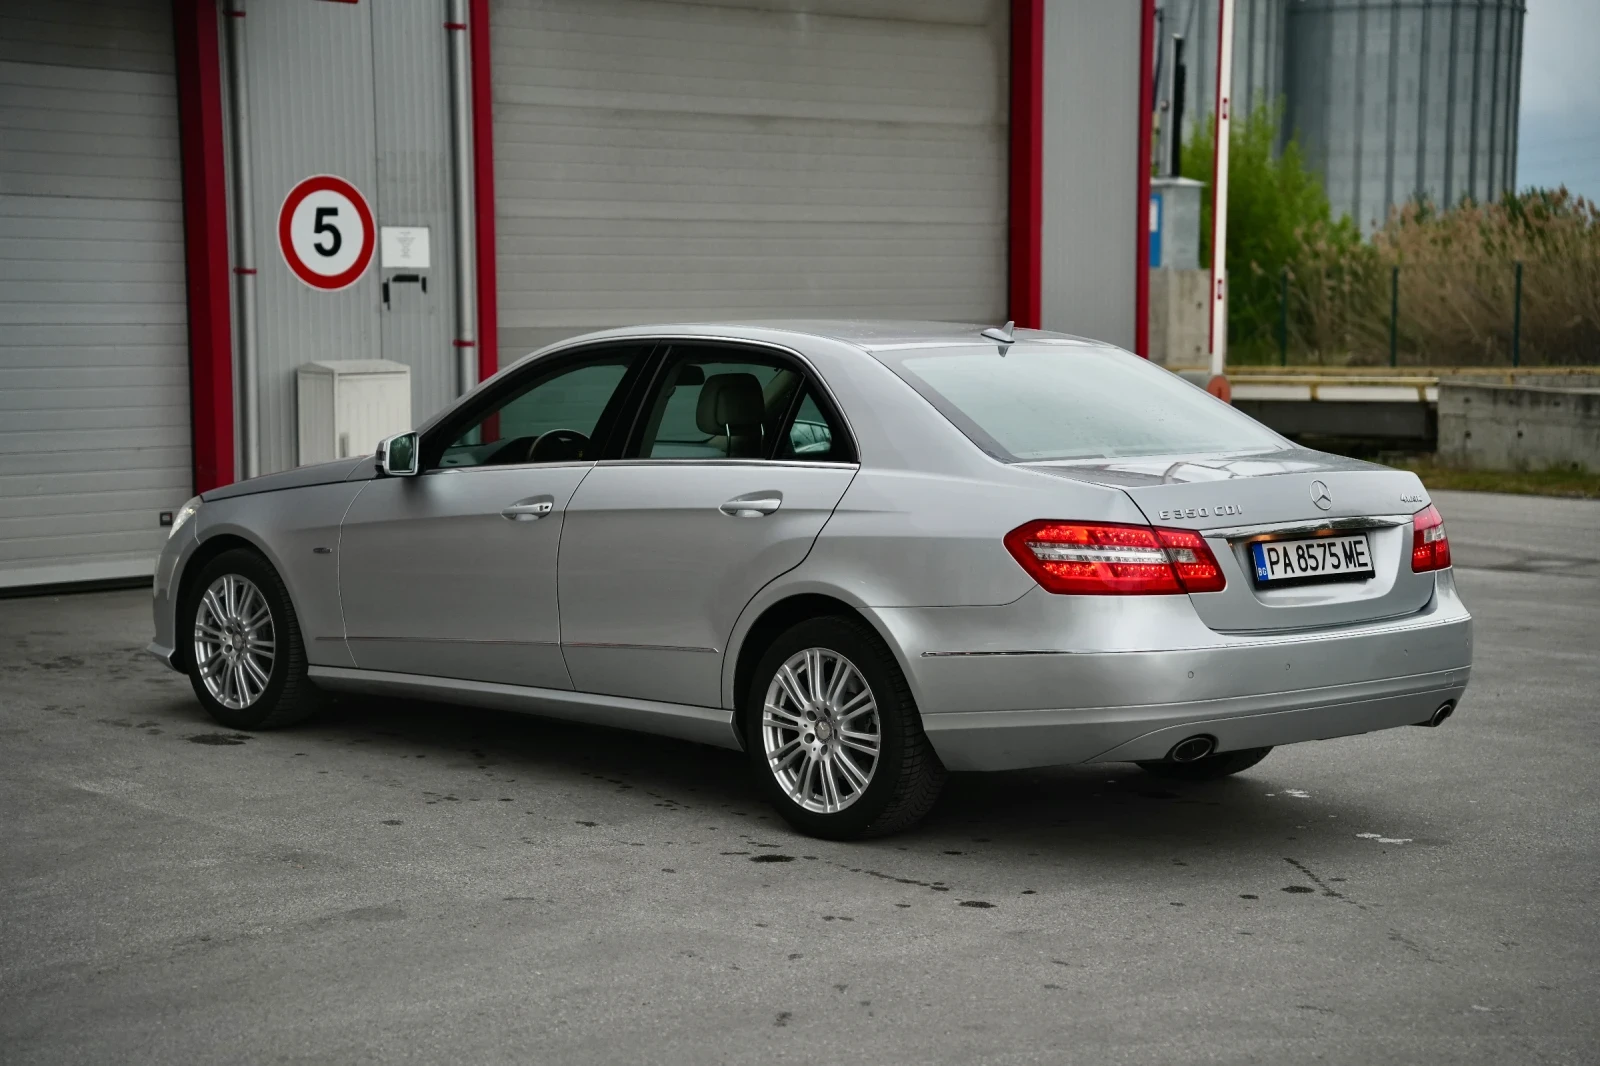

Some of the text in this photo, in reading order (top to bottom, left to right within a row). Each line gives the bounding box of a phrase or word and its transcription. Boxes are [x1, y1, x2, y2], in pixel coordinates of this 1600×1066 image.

[313, 206, 342, 258] 5
[1213, 504, 1242, 517] CDI
[1267, 540, 1369, 576] PA 8575 ME
[1258, 567, 1268, 576] BG
